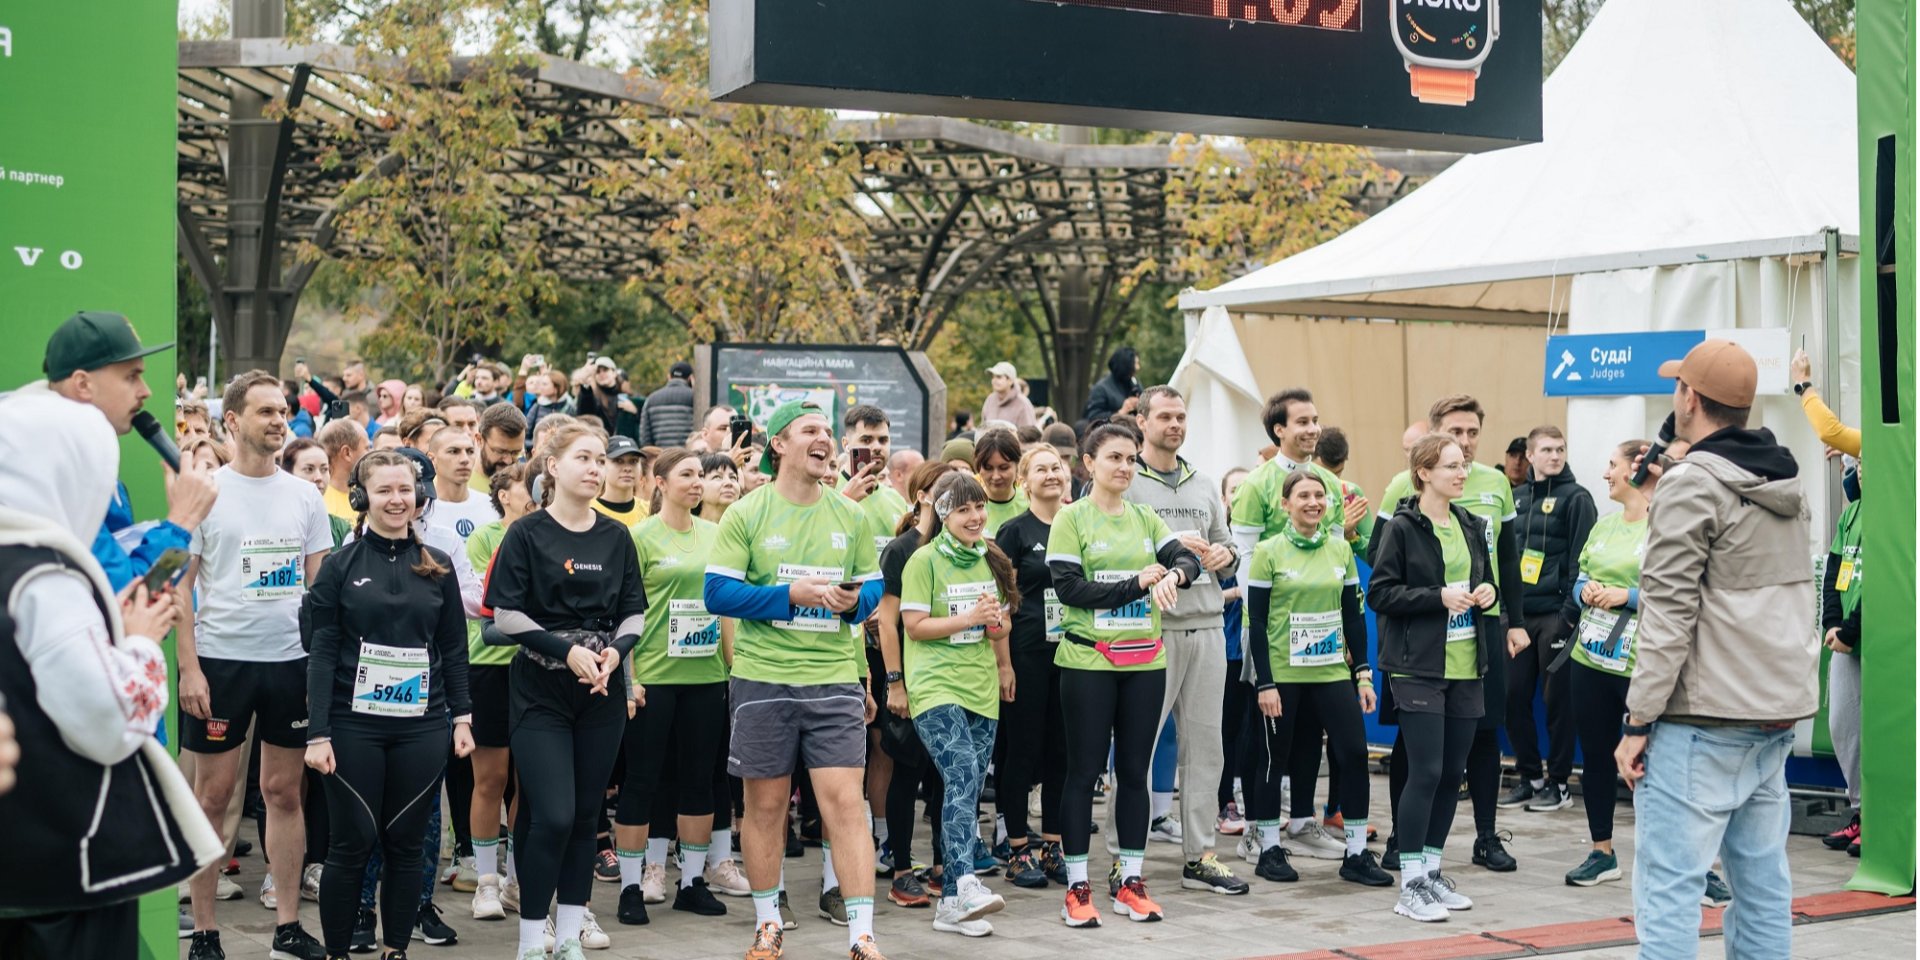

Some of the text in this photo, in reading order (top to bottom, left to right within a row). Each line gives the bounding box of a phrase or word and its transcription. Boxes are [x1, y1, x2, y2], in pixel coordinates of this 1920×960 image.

[10, 169, 64, 188] партнер
[1590, 346, 1632, 365] Судді
[825, 358, 855, 369] МАПА
[1590, 367, 1625, 381] Judges
[574, 563, 602, 571] GENESIS
[260, 571, 291, 586] 5187
[685, 630, 714, 646] 6092
[1304, 641, 1333, 656] 6123
[373, 683, 413, 703] 5946
